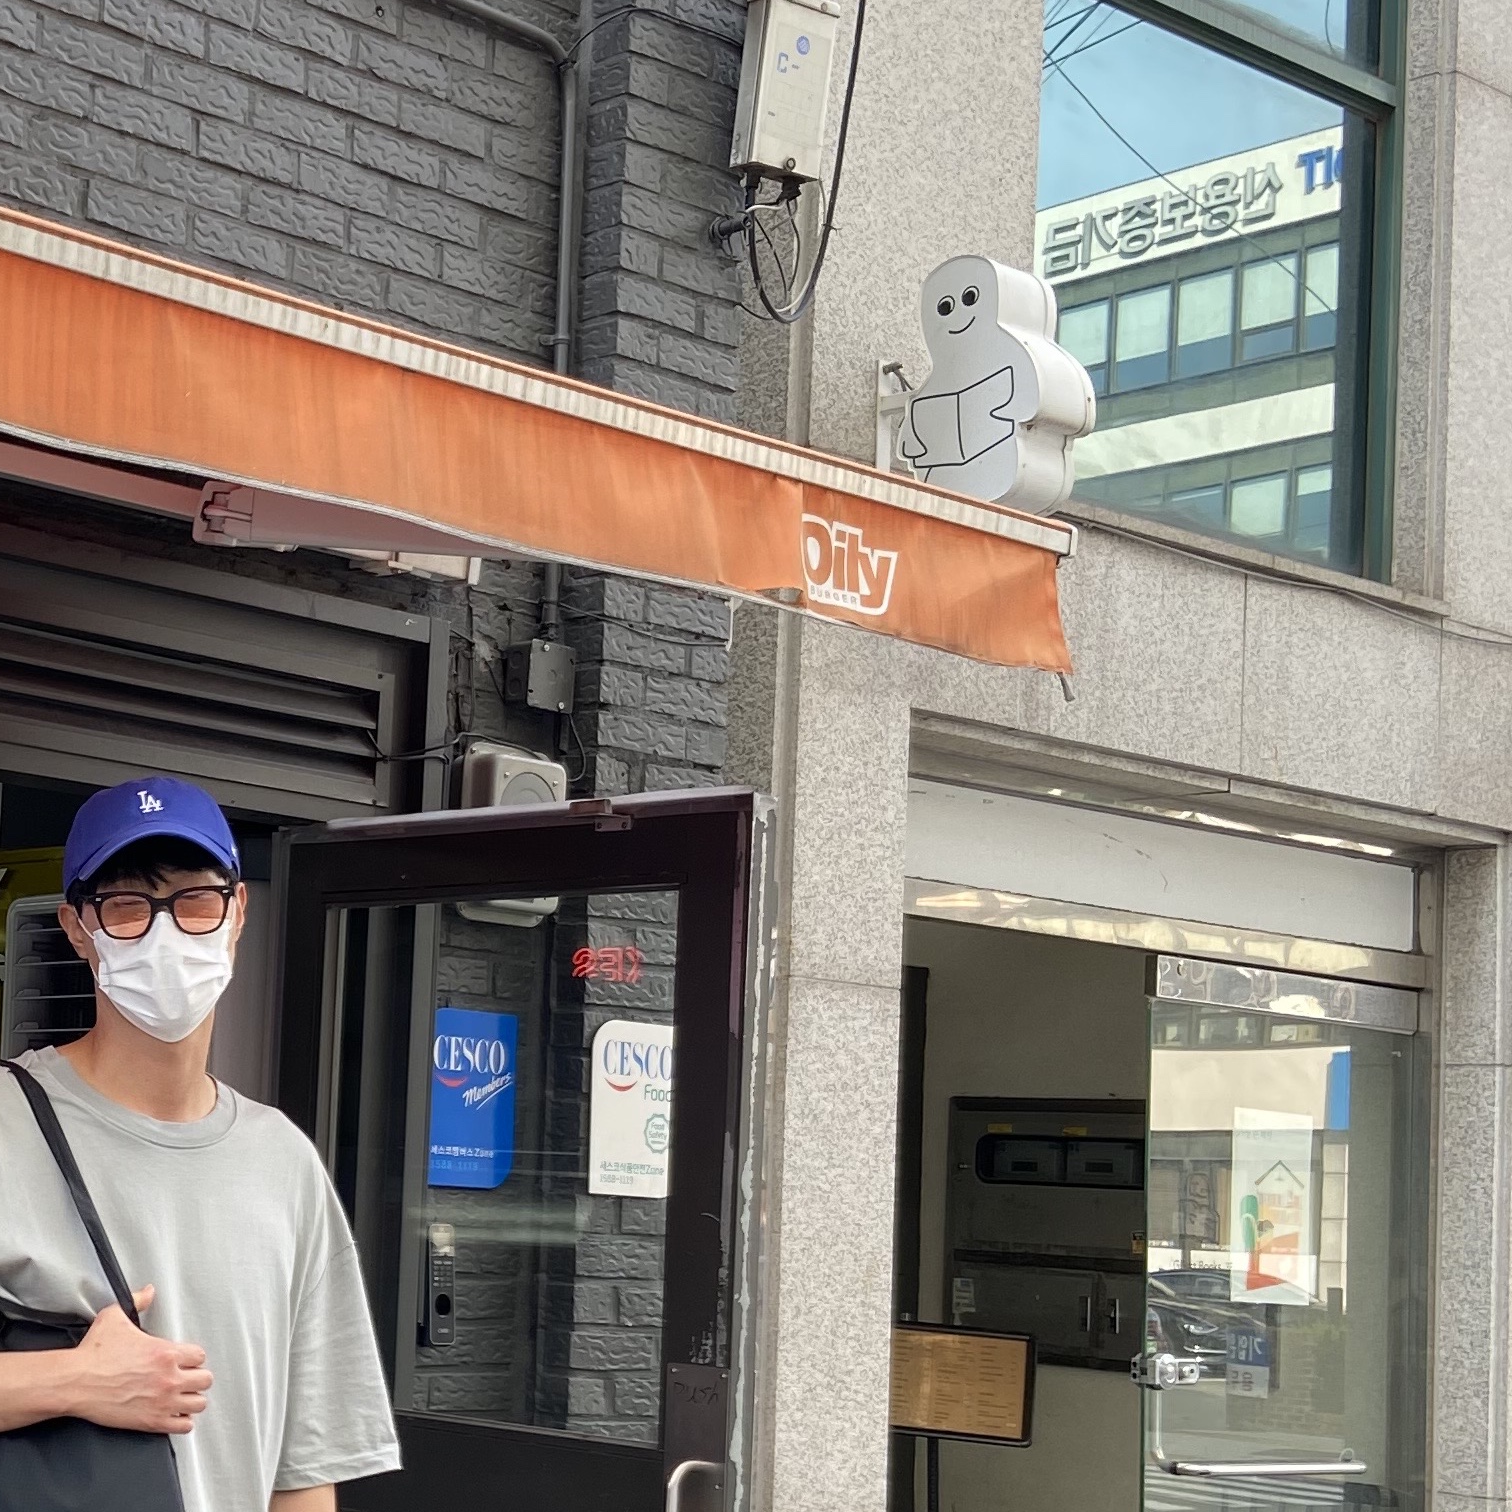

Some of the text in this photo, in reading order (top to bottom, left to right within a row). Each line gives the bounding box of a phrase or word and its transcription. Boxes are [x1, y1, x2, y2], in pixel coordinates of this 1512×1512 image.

[801, 513, 899, 615] Oily
[810, 584, 858, 606] BURGER
[138, 790, 164, 813] LA
[433, 1035, 506, 1075] CESCO
[603, 1039, 672, 1081] CESCO
[461, 1072, 513, 1107] Members
